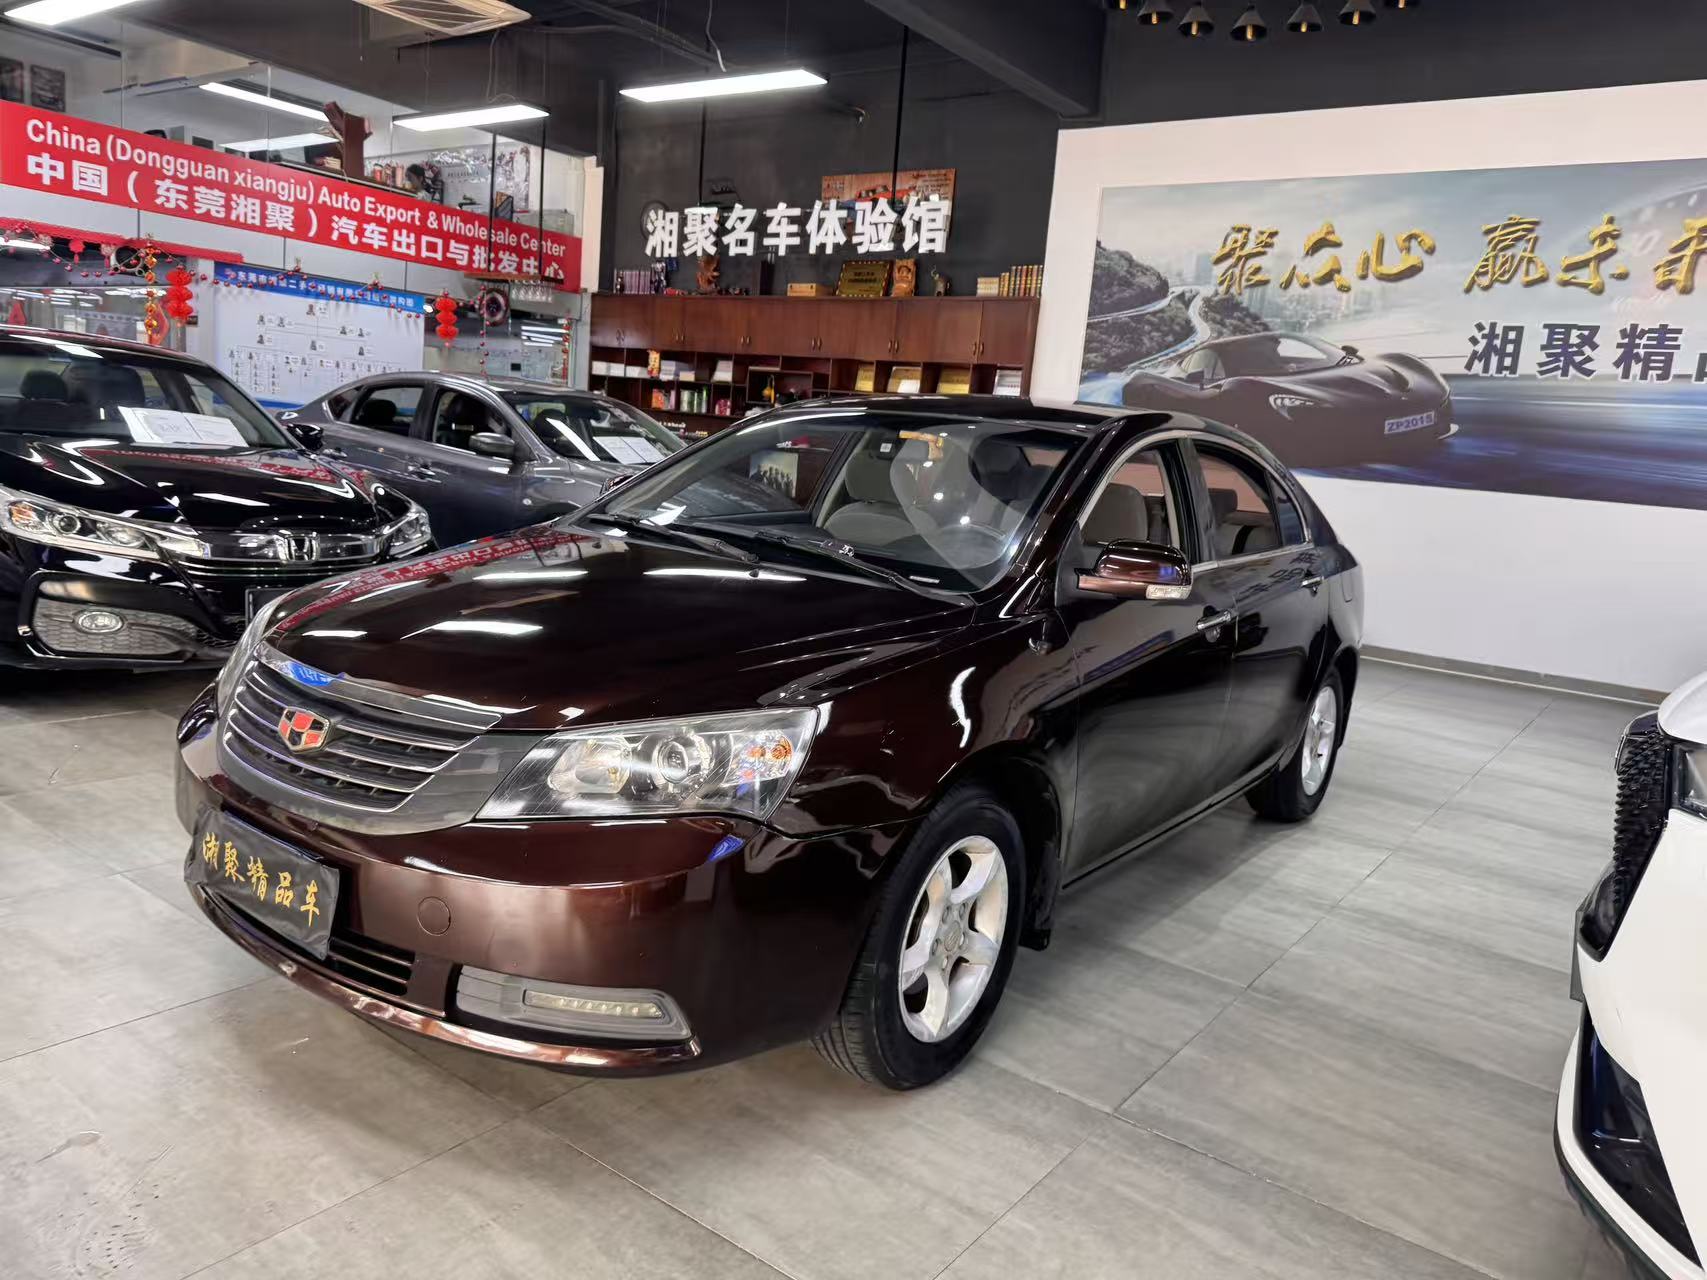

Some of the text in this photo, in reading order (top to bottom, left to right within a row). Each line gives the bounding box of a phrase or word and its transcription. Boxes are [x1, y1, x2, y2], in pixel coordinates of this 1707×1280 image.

[26, 118, 566, 258] China (Dongguan xiangju) Auto Export & Wholesale Center
[644, 193, 951, 259] 湘聚名车体验馆
[1211, 221, 1437, 296] 聚众心
[1464, 320, 1707, 384] 湘聚精
[202, 831, 320, 928] 湘聚精品车
